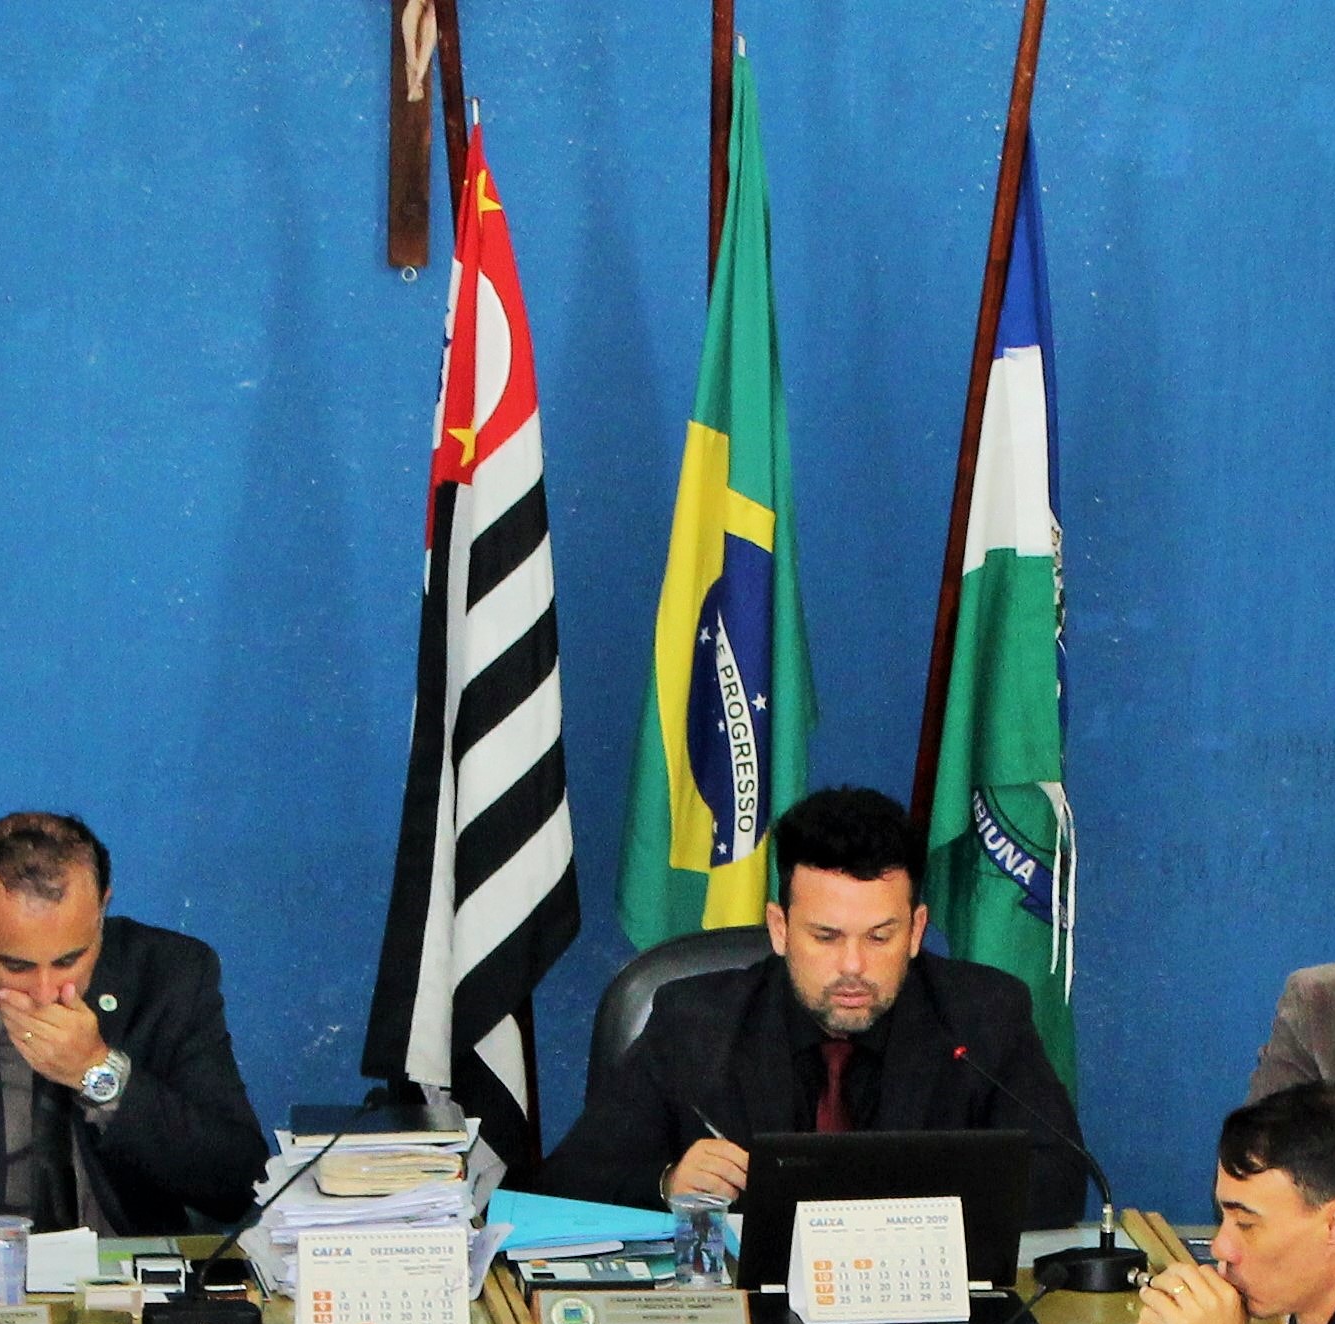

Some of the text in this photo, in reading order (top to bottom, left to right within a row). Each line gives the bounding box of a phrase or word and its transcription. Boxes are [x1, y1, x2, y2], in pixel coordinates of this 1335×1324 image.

[720, 664, 755, 833] PROGRESSO
[809, 1218, 844, 1227] CAIXA
[926, 1215, 949, 1224] 2019
[312, 1246, 454, 1257] CAIXA DEZEMBRO 2018
